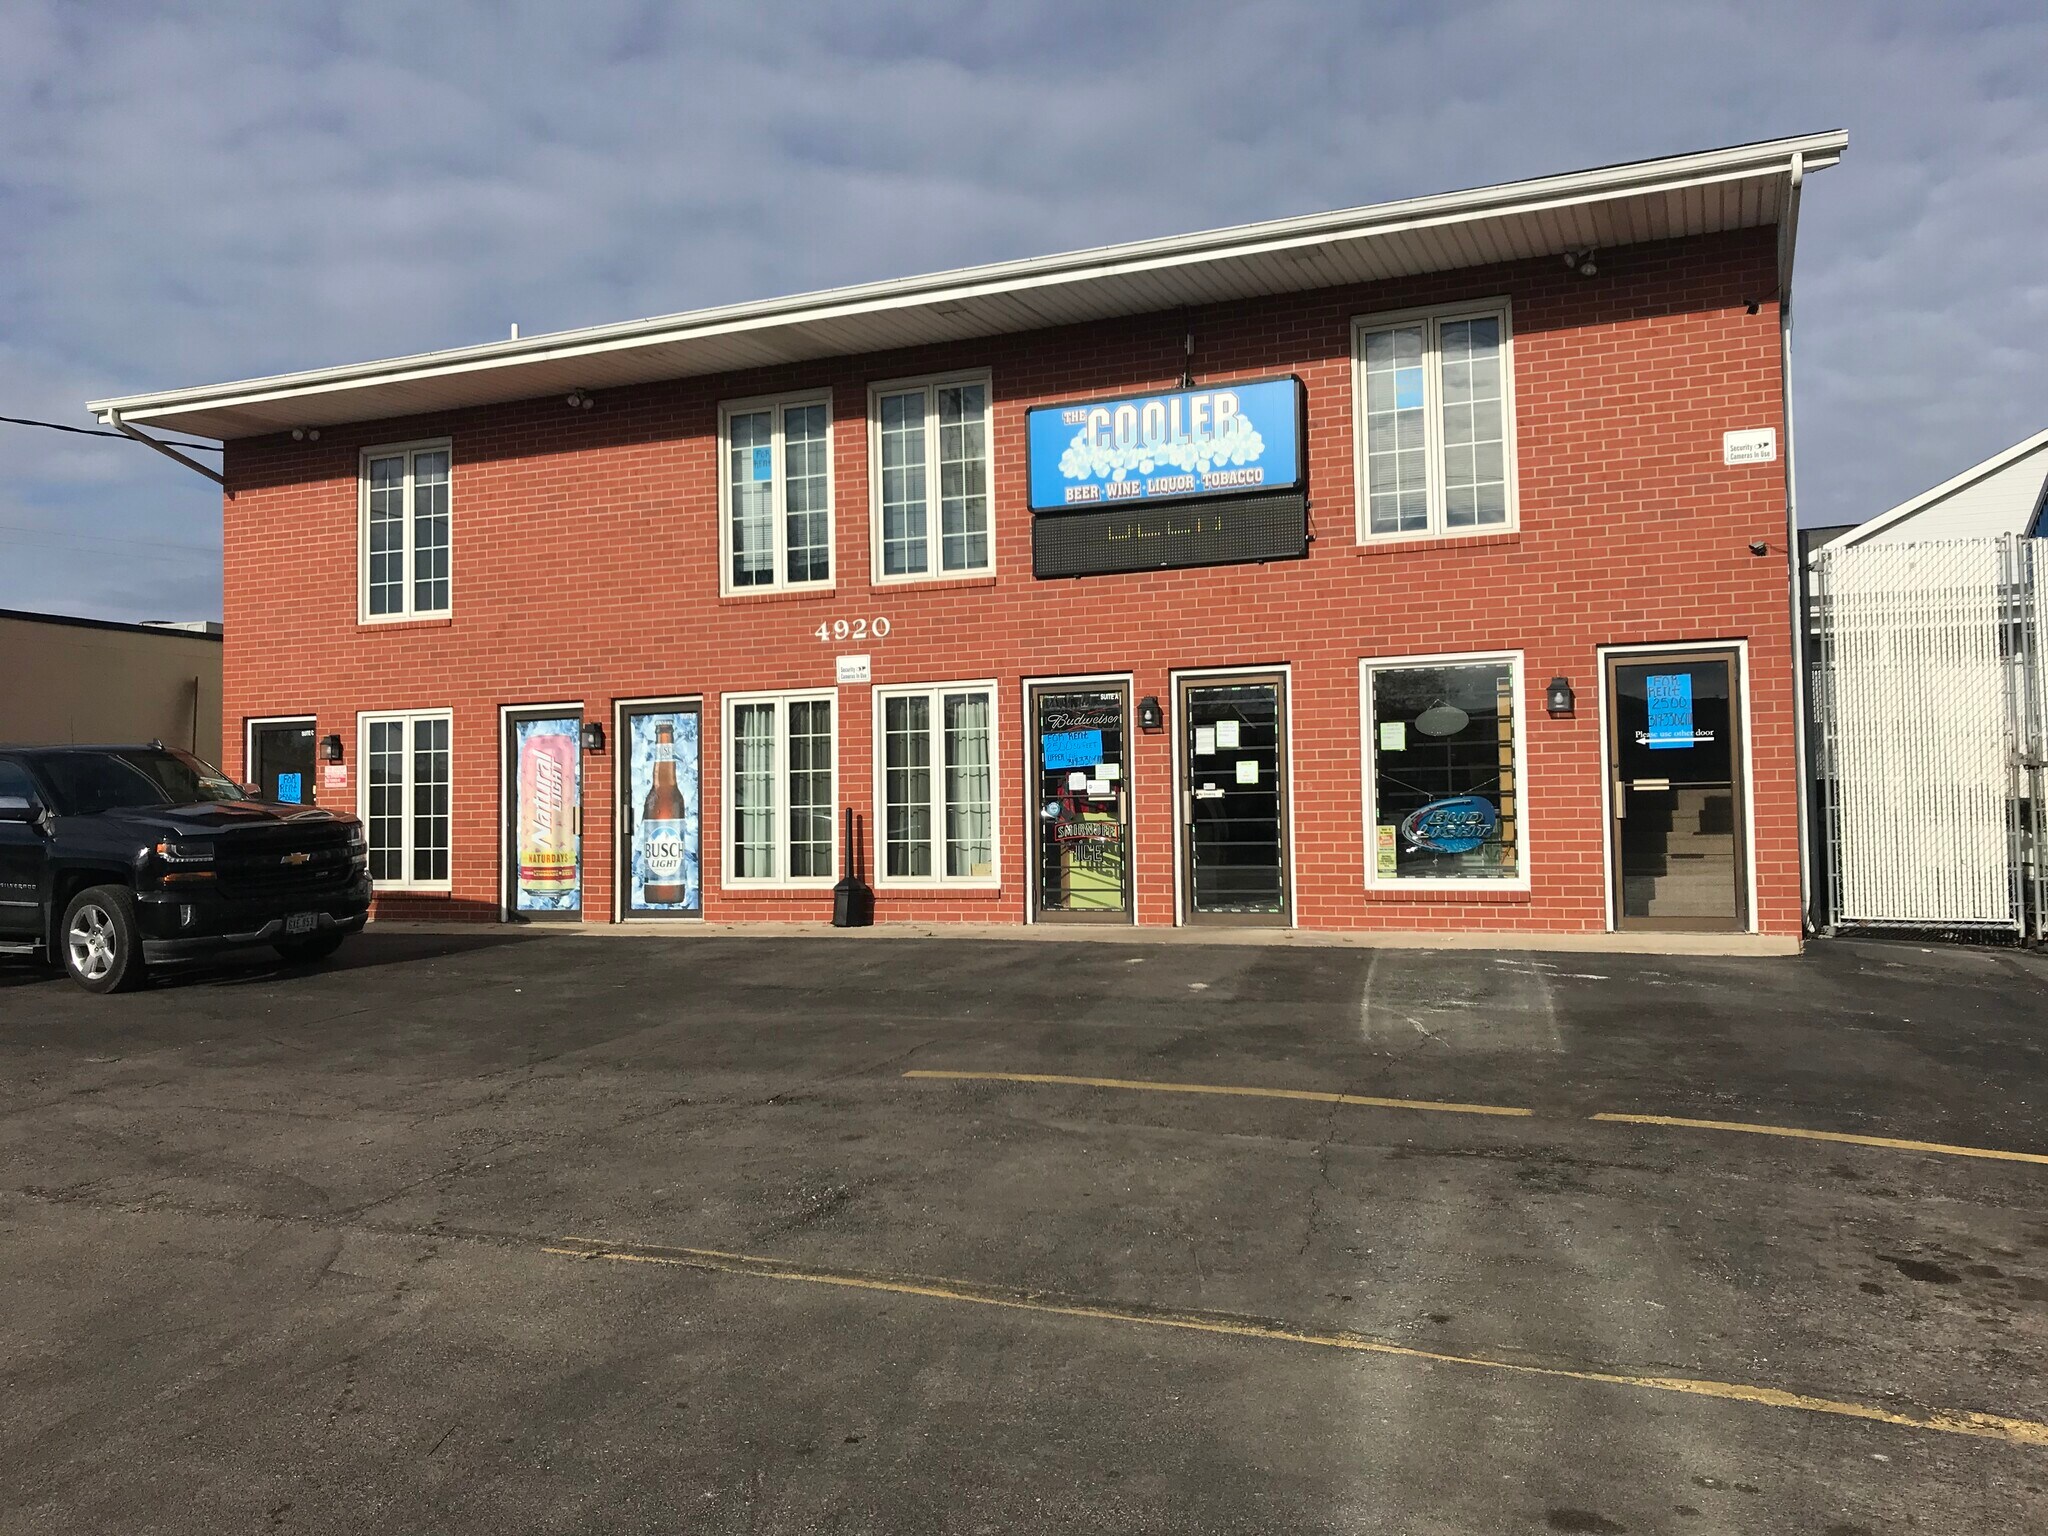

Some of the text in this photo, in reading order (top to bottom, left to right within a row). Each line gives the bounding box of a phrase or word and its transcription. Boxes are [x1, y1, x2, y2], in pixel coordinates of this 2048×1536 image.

[1063, 391, 1240, 451] THE COOLER
[1730, 444, 1753, 452] Security
[1065, 467, 1264, 504] BEER WINE LIQUOR TOBACCO
[814, 616, 891, 641] 4920
[1100, 693, 1114, 701] SUITE
[1047, 713, 1120, 730] Budweiser
[1635, 730, 1658, 738] Please
[1674, 730, 1694, 738] other
[551, 756, 563, 813] LIGHT
[531, 747, 552, 848] Natural
[1428, 809, 1485, 825] BUD
[1416, 823, 1492, 839] LIGHT
[645, 841, 684, 859] BUSCH
[528, 853, 569, 864] NATURDAYS
[651, 859, 678, 868] LIGHT
